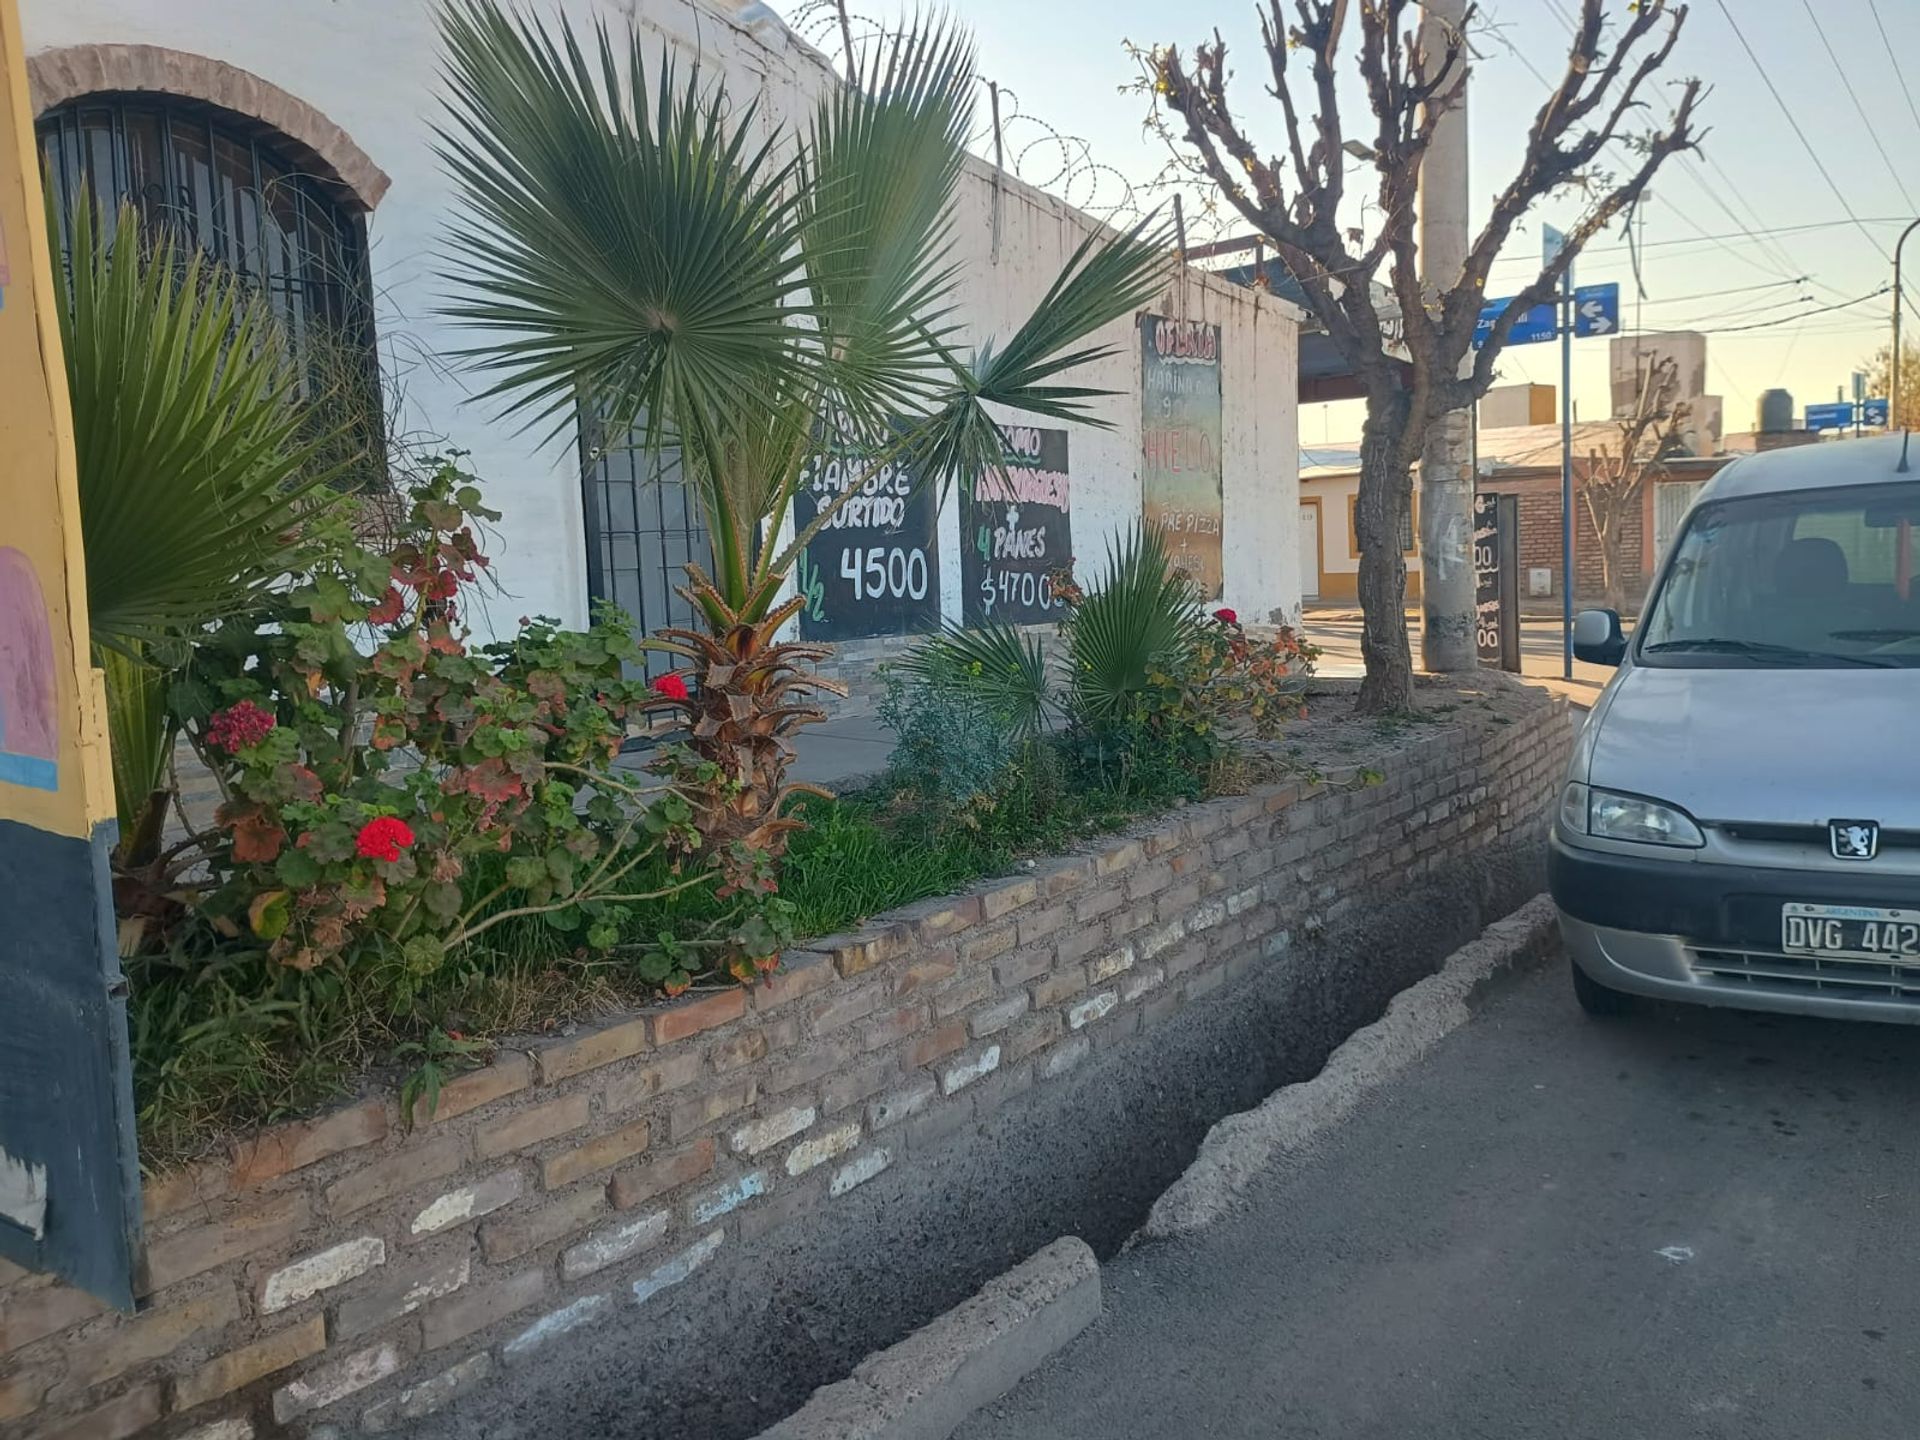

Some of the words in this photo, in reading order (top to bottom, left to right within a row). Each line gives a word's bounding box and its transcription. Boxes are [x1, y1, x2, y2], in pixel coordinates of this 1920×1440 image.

[817, 494, 905, 531] SURTIDO
[1186, 513, 1220, 536] PIZZA
[977, 525, 991, 561] 4
[994, 525, 1045, 559] PANES
[841, 547, 928, 600] 4500
[1788, 917, 1842, 949] DVG
[1861, 922, 1919, 955] 442
